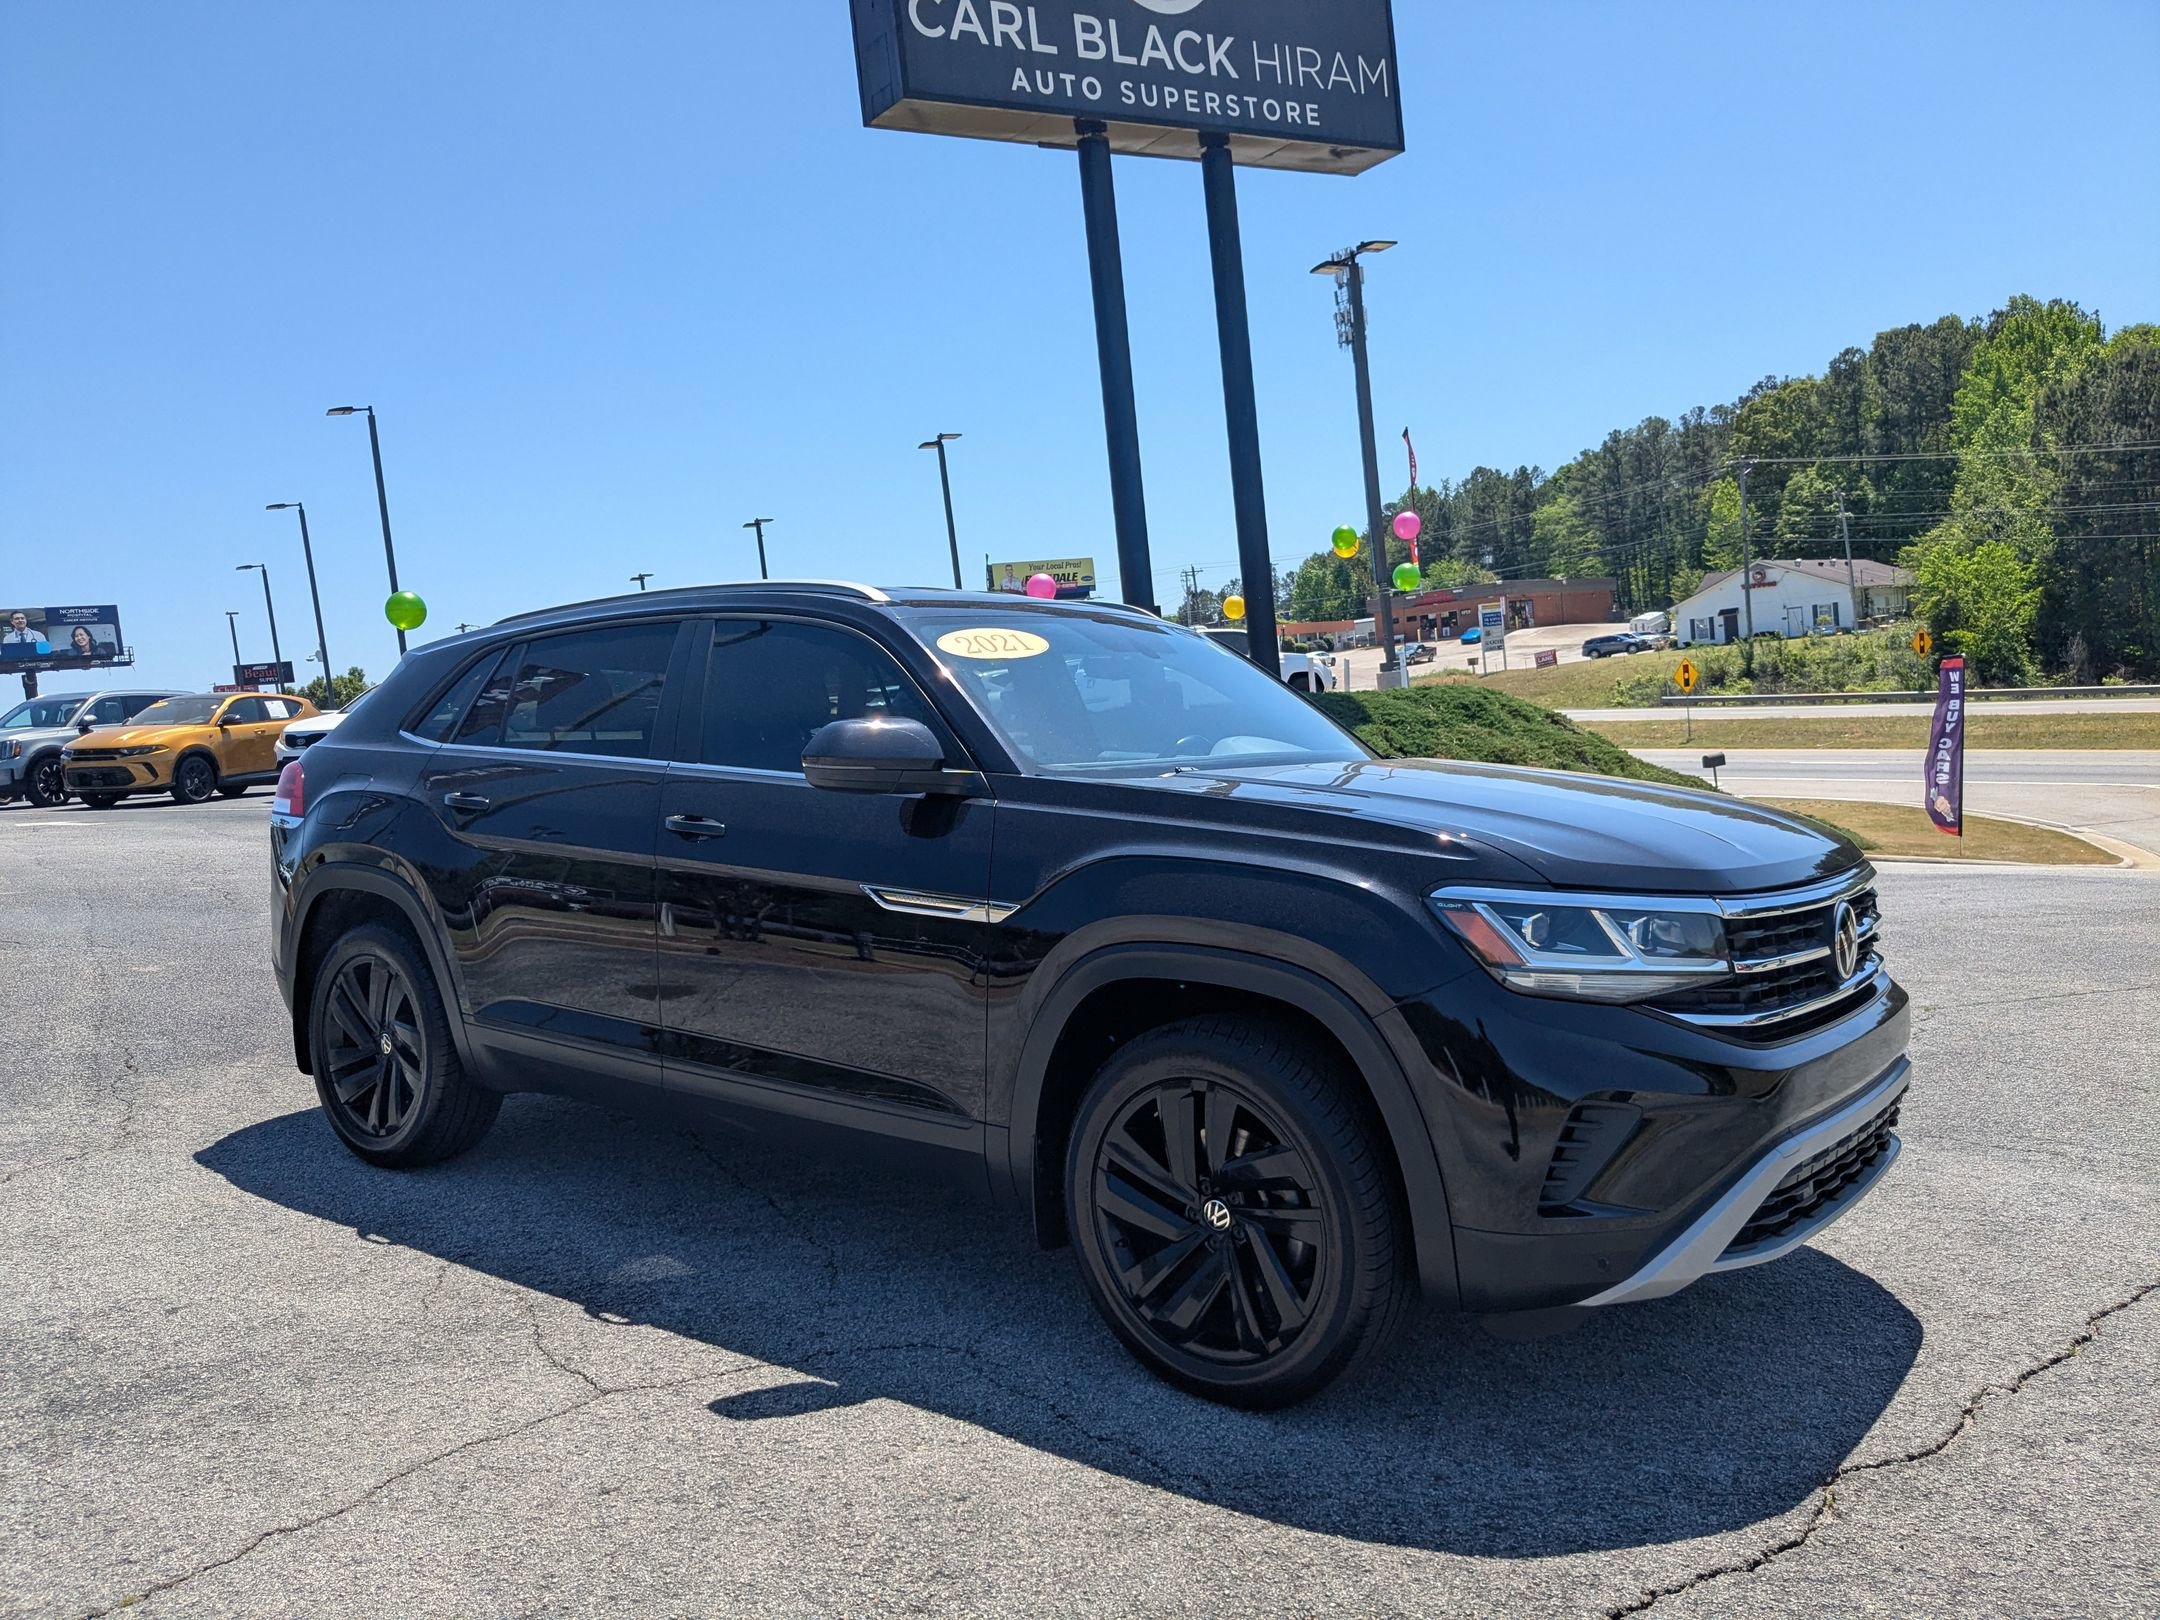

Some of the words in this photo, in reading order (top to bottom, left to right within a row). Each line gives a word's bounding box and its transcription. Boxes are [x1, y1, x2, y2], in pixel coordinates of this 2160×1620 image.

[908, 0, 1058, 54] CARL
[1073, 13, 1239, 79] BLACK
[1253, 40, 1389, 97] HIRAM
[1011, 67, 1103, 101] AUTO
[1120, 80, 1320, 126] SUPERSTORE
[1047, 562, 1063, 570] Local
[954, 633, 1034, 654] 2021
